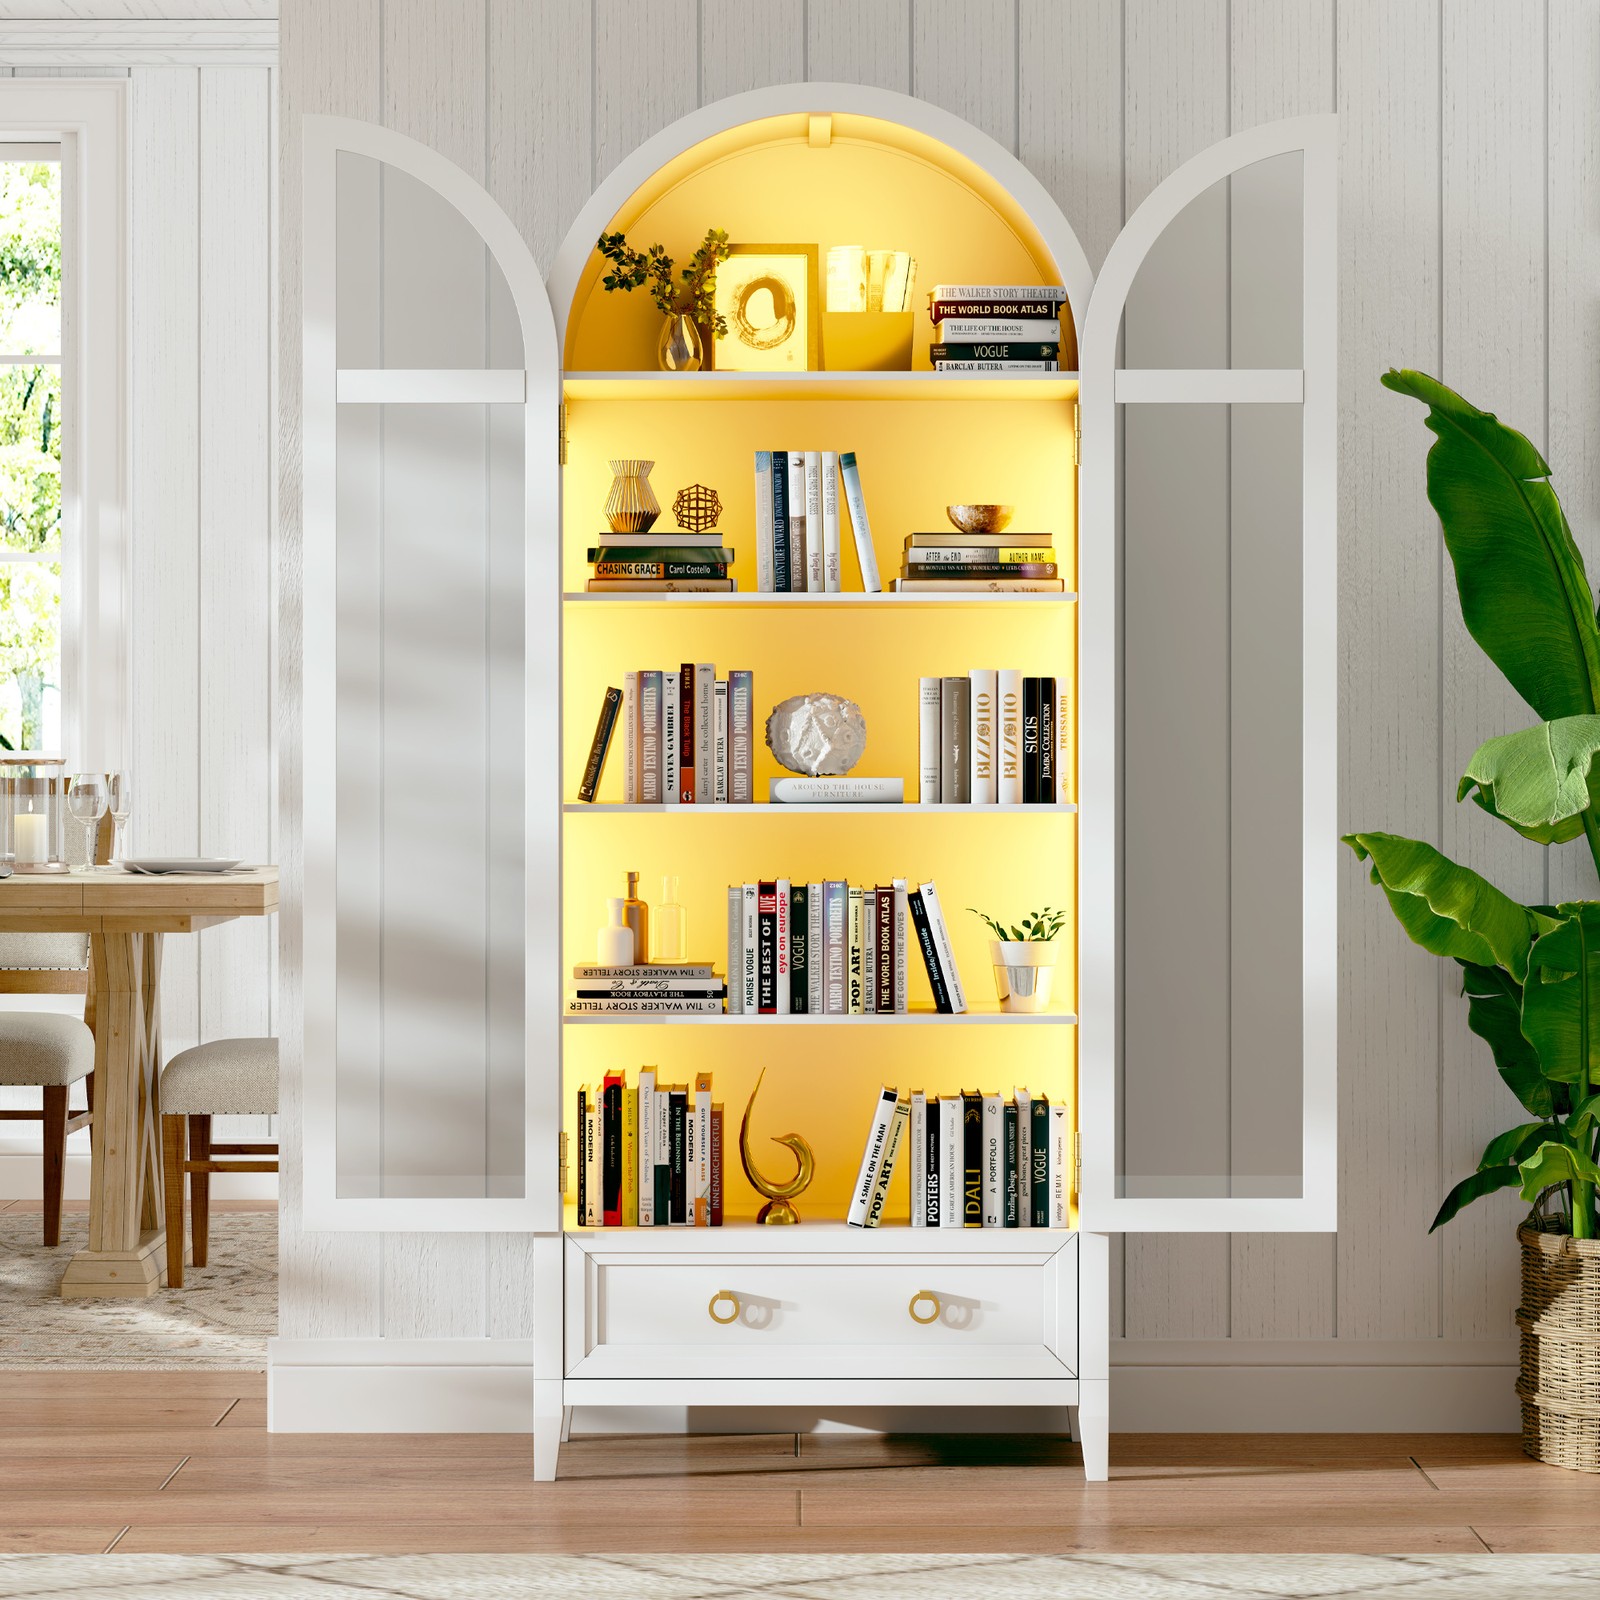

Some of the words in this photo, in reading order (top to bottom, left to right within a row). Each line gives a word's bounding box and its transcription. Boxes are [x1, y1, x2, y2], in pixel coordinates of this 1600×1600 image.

[940, 288, 957, 298] THE
[958, 288, 992, 298] WALKER
[992, 288, 1020, 298] STORY
[1020, 288, 1058, 298] THEATER
[938, 305, 957, 314] THE
[959, 305, 991, 314] WORLD
[993, 305, 1019, 314] BOOK
[1020, 305, 1048, 314] ATLAS
[973, 345, 1009, 358] VOGUE
[946, 362, 975, 370] BARCLAY
[977, 362, 1003, 370] BUTERA
[775, 519, 785, 547] INWARD
[597, 564, 633, 574] CHASING
[634, 564, 661, 574] GRACE
[775, 549, 786, 588] ADVENTURE
[926, 552, 941, 561] AFTER
[950, 552, 962, 561] END
[1009, 552, 1028, 562] AUTHOR
[1031, 552, 1045, 562] NAME
[669, 565, 686, 574] Carol
[686, 565, 711, 574] Costello
[683, 700, 691, 715] The
[667, 703, 675, 751] GAMBREL
[683, 716, 691, 737] Black
[1025, 716, 1038, 753] SICIS
[1060, 695, 1068, 750] TRUSSARDI
[643, 736, 657, 770] TESTINO
[682, 740, 691, 757] Tulip
[734, 736, 747, 770] TESTINO
[667, 752, 675, 791] STEVEN
[643, 772, 657, 800] MARIO
[701, 777, 709, 796] darryl
[734, 772, 747, 800] MARIO
[759, 895, 776, 913] LIVE
[778, 892, 787, 933] europe
[810, 893, 820, 930] THEATER
[881, 896, 890, 924] ATLAS
[762, 918, 771, 937] OF
[881, 926, 890, 951] BOOK
[778, 935, 787, 951] on
[792, 934, 805, 970] VOGUE
[810, 931, 820, 961] STORY
[897, 944, 905, 958] THE
[921, 927, 940, 980] Inside/Outside
[746, 948, 754, 976] VOGUE
[762, 939, 771, 975] BEST
[778, 953, 787, 974] eye
[829, 946, 843, 981] TESTINO
[851, 945, 860, 976] ART
[866, 948, 874, 973] BUTERA
[897, 959, 905, 971] TO
[810, 962, 820, 994] WALKER
[881, 954, 890, 988] WORLD
[897, 972, 905, 992] GOES
[746, 977, 754, 1006] PARISE
[762, 977, 771, 1006] THE
[829, 983, 843, 1011] MARIO
[851, 978, 860, 1007] POP
[866, 976, 874, 1005] BARCLAY
[881, 989, 890, 1006] THE
[897, 993, 905, 1011] LIFE
[570, 1002, 603, 1010] TELLER
[605, 1002, 638, 1010] STORY
[641, 1002, 682, 1010] WALKER
[686, 1002, 704, 1010] TIM
[810, 995, 820, 1012] THE
[874, 1123, 887, 1143] MAN
[894, 1121, 902, 1137] WORKS
[1020, 1126, 1028, 1146] pieces
[643, 1149, 649, 1157] of
[712, 1118, 720, 1208] INNENARCHITEKTUR
[871, 1144, 881, 1159] THE
[1020, 1147, 1028, 1161] great
[867, 1160, 877, 1173] ON
[1034, 1148, 1046, 1184] VOGUE
[860, 1173, 873, 1198] SMILE
[870, 1191, 883, 1220] POP
[879, 1159, 893, 1190] ART
[965, 1169, 981, 1215] DALI
[1007, 1170, 1018, 1192] Design
[1020, 1181, 1028, 1197] good
[927, 1173, 938, 1222] POSTERS
[1007, 1192, 1018, 1221] Dazzling
